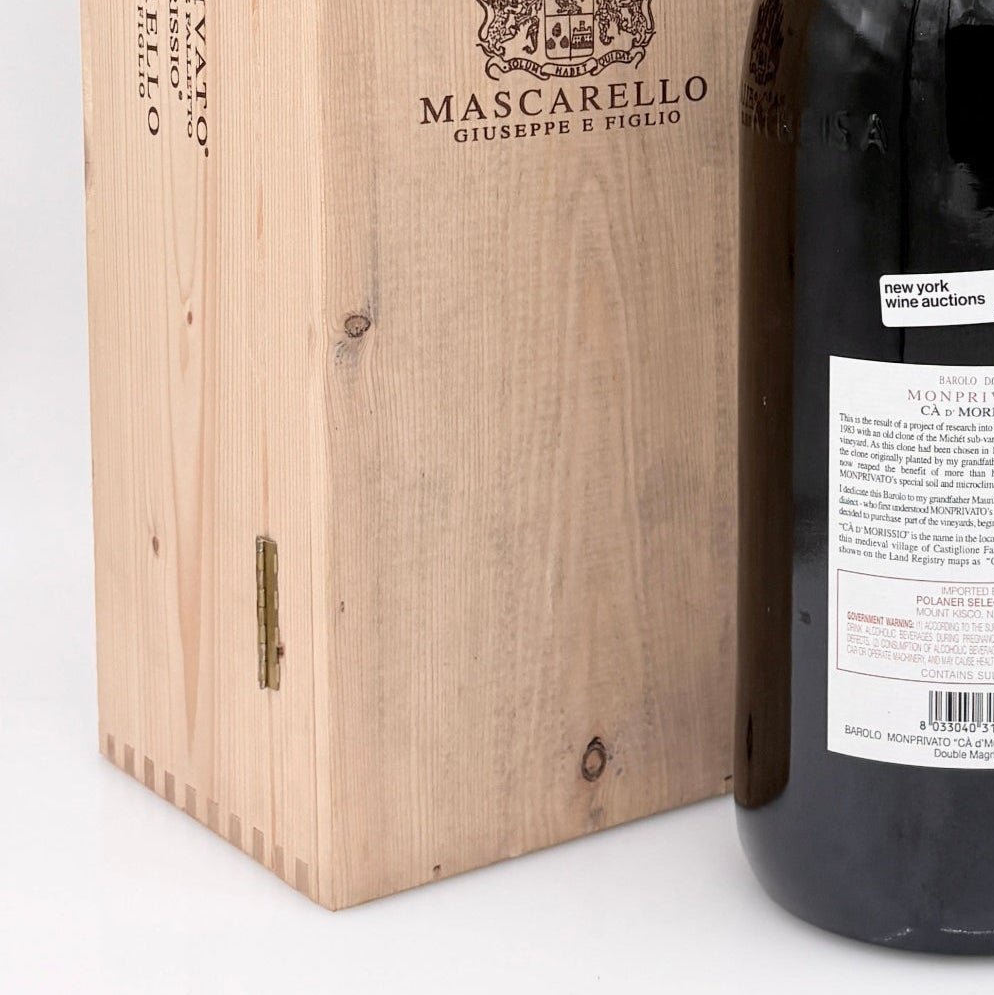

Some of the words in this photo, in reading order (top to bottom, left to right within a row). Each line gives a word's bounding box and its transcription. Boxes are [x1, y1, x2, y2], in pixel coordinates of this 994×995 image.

[137, 6, 146, 99] FIGLIO
[507, 59, 540, 74] SOLUM
[185, 11, 194, 139] FALLETTO
[419, 75, 708, 125] MASCARELLO
[454, 120, 571, 143] GIUSEPPE
[582, 118, 594, 133] E
[605, 110, 681, 130] FIGLIO
[884, 282, 913, 294] new
[916, 280, 950, 295] york
[885, 295, 919, 308] wine
[922, 294, 986, 308] auctions
[939, 375, 978, 386] BAROLO
[920, 404, 941, 416] CÀ
[840, 414, 853, 423] This
[862, 417, 872, 425] the
[873, 418, 892, 427] result
[894, 420, 900, 428] of
[909, 422, 933, 431] project
[946, 423, 976, 431] research
[840, 425, 854, 434] 1983
[856, 427, 870, 436] with
[882, 430, 893, 438] old
[895, 432, 914, 440] clone
[882, 442, 894, 450] this
[896, 443, 915, 451] clone
[918, 444, 931, 452] had
[934, 445, 950, 453] been
[839, 447, 848, 455] the
[850, 449, 868, 458] clone
[870, 452, 903, 464] originally
[905, 455, 931, 466] planted
[934, 457, 943, 466] by
[946, 459, 958, 467] my
[858, 461, 879, 473] reaped
[900, 466, 925, 475] benefit
[899, 477, 923, 488] special
[926, 479, 938, 487] soil
[839, 544, 861, 555] shown
[875, 551, 886, 559] the
[889, 552, 908, 561] Land
[911, 554, 944, 566] Registry
[941, 586, 988, 596] IMPORTED
[916, 596, 964, 606] POLANER
[916, 608, 950, 617] MOUNT
[921, 668, 974, 680] CONTAINS
[920, 720, 926, 730] 8
[932, 722, 976, 733] 033040
[844, 724, 882, 740] BAROLO
[887, 732, 951, 747] MONPRIVATO
[954, 736, 972, 748] "CÀ
[934, 748, 967, 759] Double
